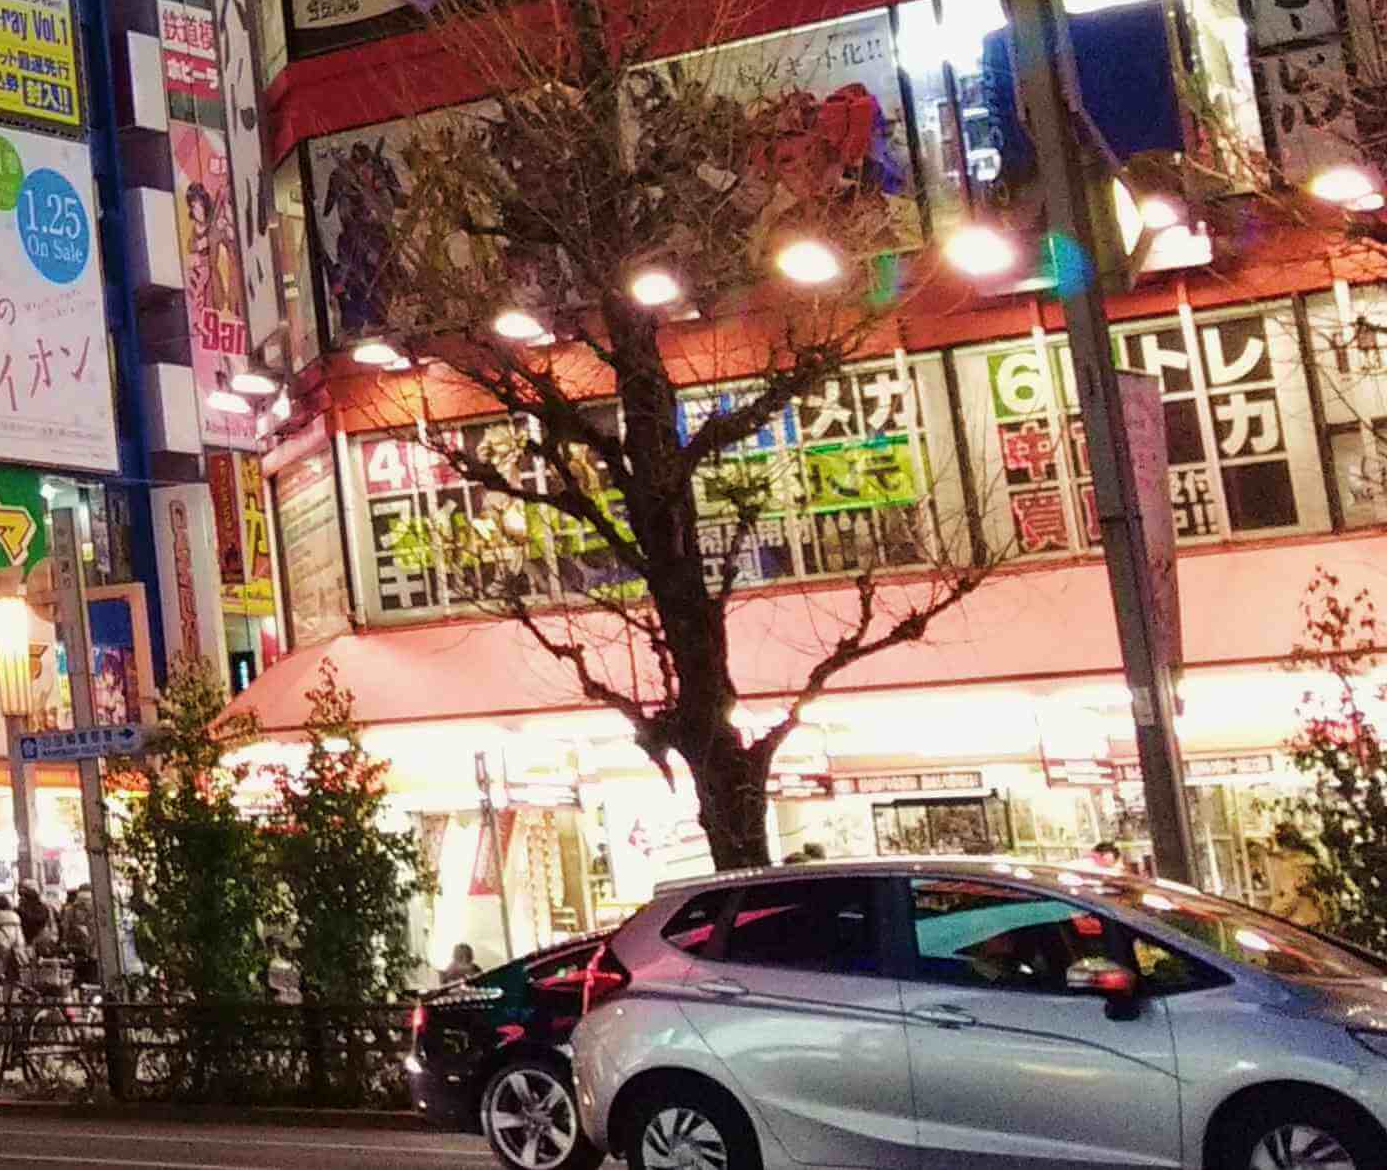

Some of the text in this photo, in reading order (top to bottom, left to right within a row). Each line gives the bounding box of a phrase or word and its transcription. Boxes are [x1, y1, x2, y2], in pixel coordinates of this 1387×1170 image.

[31, 9, 68, 47] Vol.1
[26, 188, 82, 239] 1.25
[27, 238, 84, 265] On Sale
